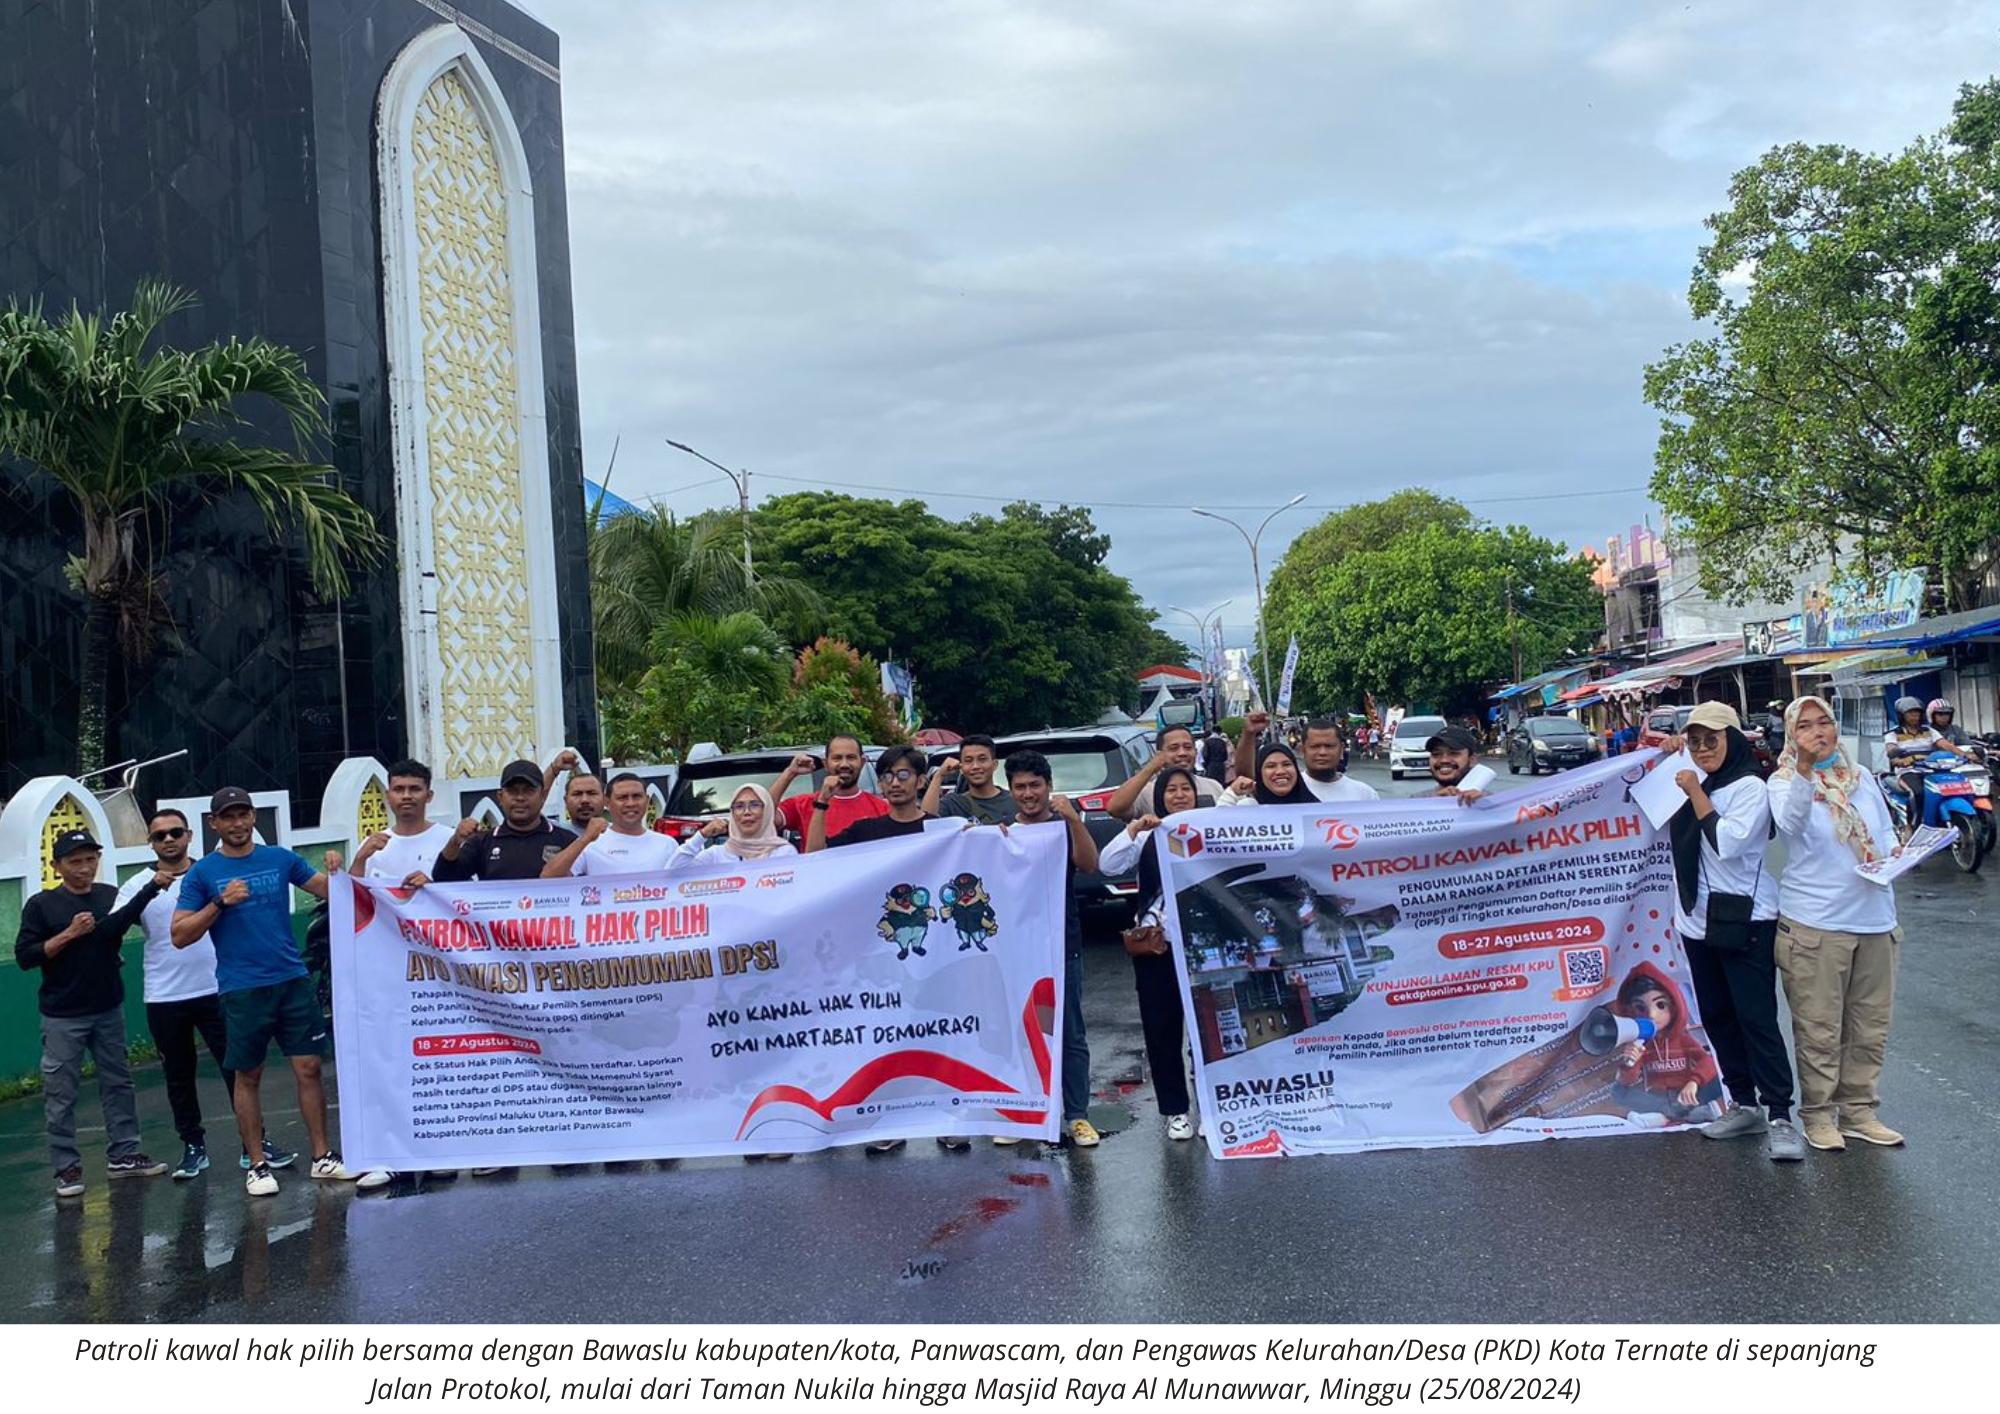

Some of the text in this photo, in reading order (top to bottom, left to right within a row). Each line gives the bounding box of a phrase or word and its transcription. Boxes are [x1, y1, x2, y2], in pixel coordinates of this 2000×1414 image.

[1204, 824, 1293, 839] BAWASLU
[1363, 819, 1425, 830] NUSANTARA
[1364, 824, 1452, 839] INDONESIA MAJU
[1207, 843, 1294, 853] KOTA TERNATE
[1331, 815, 1641, 881] PATROLI KAWAL HAK PILIH
[1398, 853, 1600, 895] PENGUMUMAN DAFTAR PEMILIH
[1401, 862, 1645, 908] DALAM RANGKA PEMILIHAN SERENTAK
[1404, 880, 1623, 921] Tahapan Pengumuman Daftar Pemilih
[1414, 894, 1601, 930] (DPS) di Tingkat Kelurahan/Desa
[396, 903, 709, 950] PATROLI KAWAL HAK PILIH
[1452, 924, 1592, 952] 18-27 Agustus 2024
[406, 939, 779, 994] AYO AWASI PENGUMUMAN DPS!
[1366, 960, 1555, 993] KUNJUNGI LAMAN RESMI KPU
[411, 991, 452, 1001] Tahapan
[542, 1001, 578, 1010] Pemilih
[580, 996, 633, 1008] Sementara
[635, 993, 663, 1003] (DPS)
[1392, 976, 1518, 1003] cekdptonline.kpu.go.id
[411, 1002, 625, 1021] Oleh Panitia ditingkat
[411, 1015, 467, 1026] Kelurahan/
[706, 991, 901, 1028] AYO KAWAL HAK PILIH
[710, 1014, 980, 1058] DEMI MARTABAT DEMOKRASI
[1292, 1010, 1568, 1047] Laporkan Kepada Bawaslu atau Panwas Kecamatan
[1294, 1020, 1569, 1056] di Wilayah anda, Jika anda belum terdaftar sebagai
[417, 1040, 431, 1049] 18
[441, 1039, 456, 1048] 27
[459, 1036, 510, 1049] Agustus
[1328, 1034, 1536, 1061] Pemilih Pemilihan serentak Tahun 2024
[412, 1056, 684, 1071] Cek Status Hak Pilih Laporkan
[411, 1069, 674, 1086] juga jika terdapat Pemilih Memenuhi Syarat
[412, 1089, 443, 1099] masih
[445, 1087, 489, 1097] terdaftar
[491, 1085, 501, 1094] di
[503, 1085, 524, 1093] DPS
[526, 1083, 548, 1092] atau
[550, 1082, 585, 1092] dugaan
[647, 1079, 683, 1090] lainnya
[1214, 1070, 1335, 1101] BAWASLU
[412, 1103, 449, 1112] selama
[450, 1101, 492, 1112] tahapan
[493, 1097, 564, 1108] Pemutakhiran
[566, 1094, 588, 1103] data
[626, 1095, 638, 1103] ke
[639, 1093, 672, 1102] kantor
[1217, 1087, 1336, 1114] KOTA TERNATE
[413, 1105, 644, 1126] Bawaslu Provinsi Maluku Utara, Kantor Bawaslu
[413, 1120, 632, 1140] Kabupaten/Kota dan Sekretariat Panwascam
